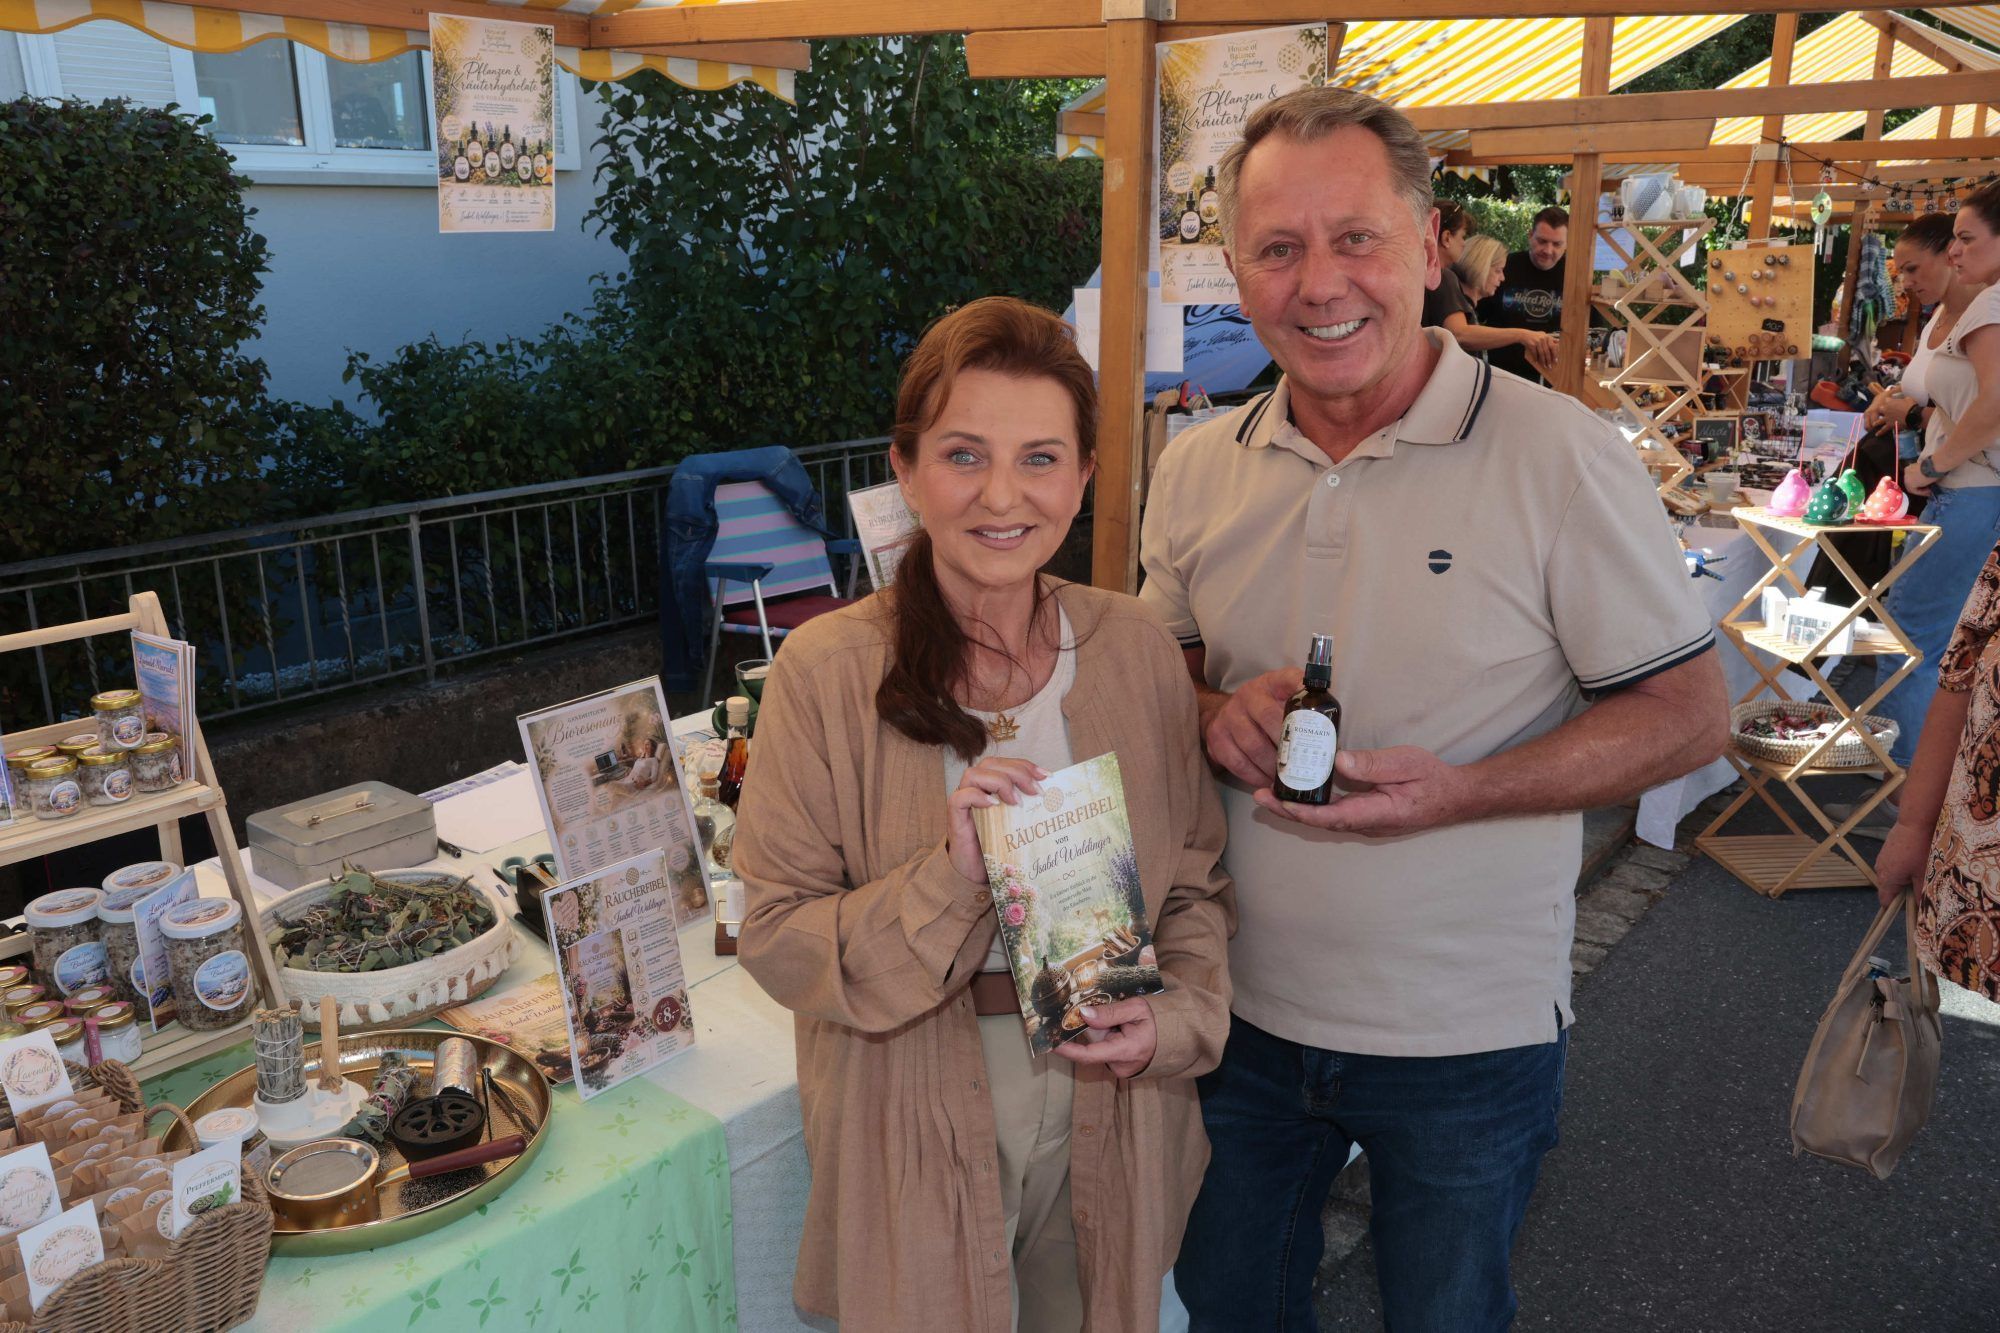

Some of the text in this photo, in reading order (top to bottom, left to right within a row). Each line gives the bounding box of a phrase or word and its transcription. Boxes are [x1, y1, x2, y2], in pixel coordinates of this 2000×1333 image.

[463, 61, 521, 81] Pflanzen &
[450, 72, 538, 97] Kräuterhydrolate
[1197, 83, 1279, 116] Pflanzen &
[1180, 107, 1248, 135] Kräuterh
[1186, 277, 1237, 294] Isabel Waldinge
[1514, 292, 1539, 304] Hard
[1294, 726, 1331, 737] ROSMARIN
[1003, 796, 1117, 852] RÄUCHERFIBEL
[1055, 835, 1069, 845] von
[1028, 836, 1112, 880] Isabel Waldinger
[604, 877, 667, 908] RÄUCHERFIBEL
[610, 905, 634, 926] Isabel
[530, 1004, 563, 1018] Waldin
